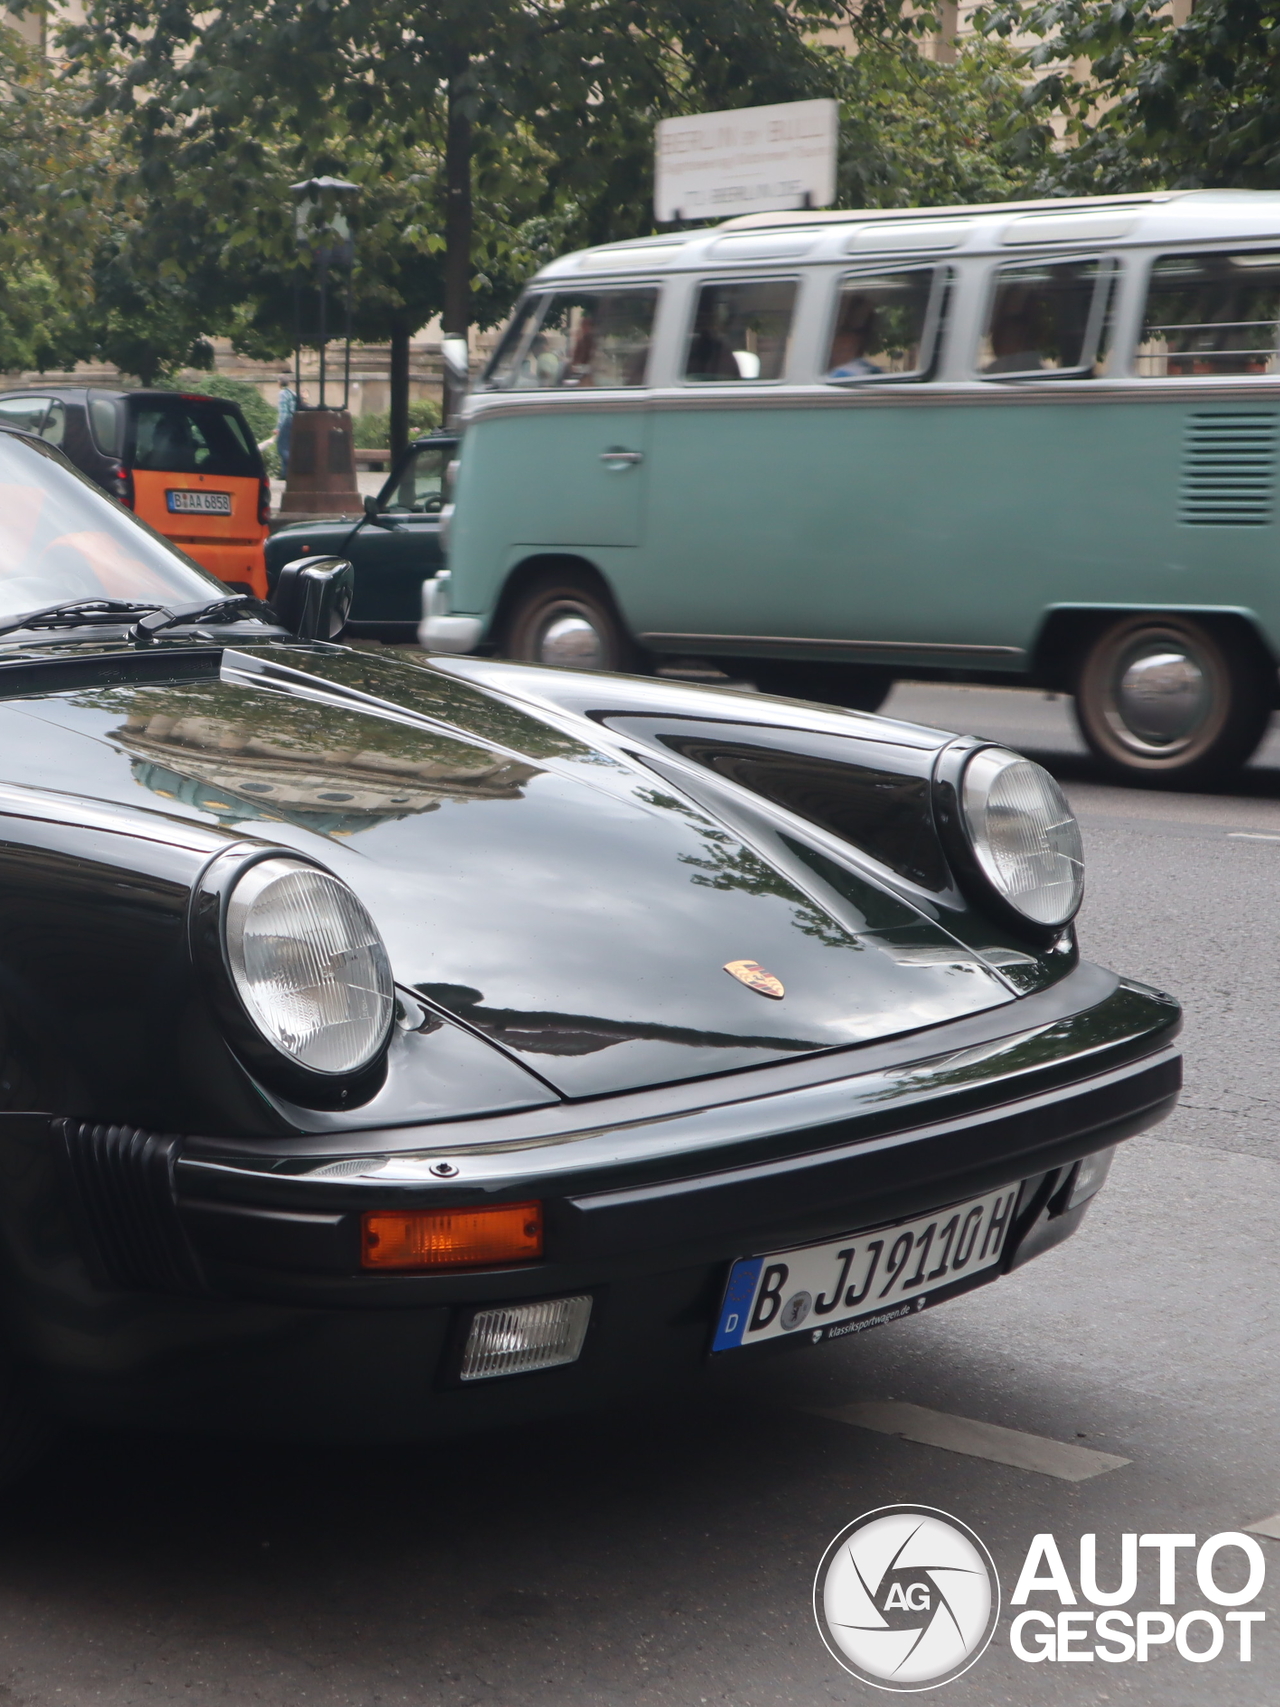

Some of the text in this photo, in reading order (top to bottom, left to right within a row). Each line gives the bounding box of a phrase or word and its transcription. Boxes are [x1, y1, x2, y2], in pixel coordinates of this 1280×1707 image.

[174, 494, 229, 510] B AA 6858
[748, 1263, 789, 1332] B
[725, 1314, 739, 1333] D
[828, 1305, 911, 1338] klassiksportwagen.de
